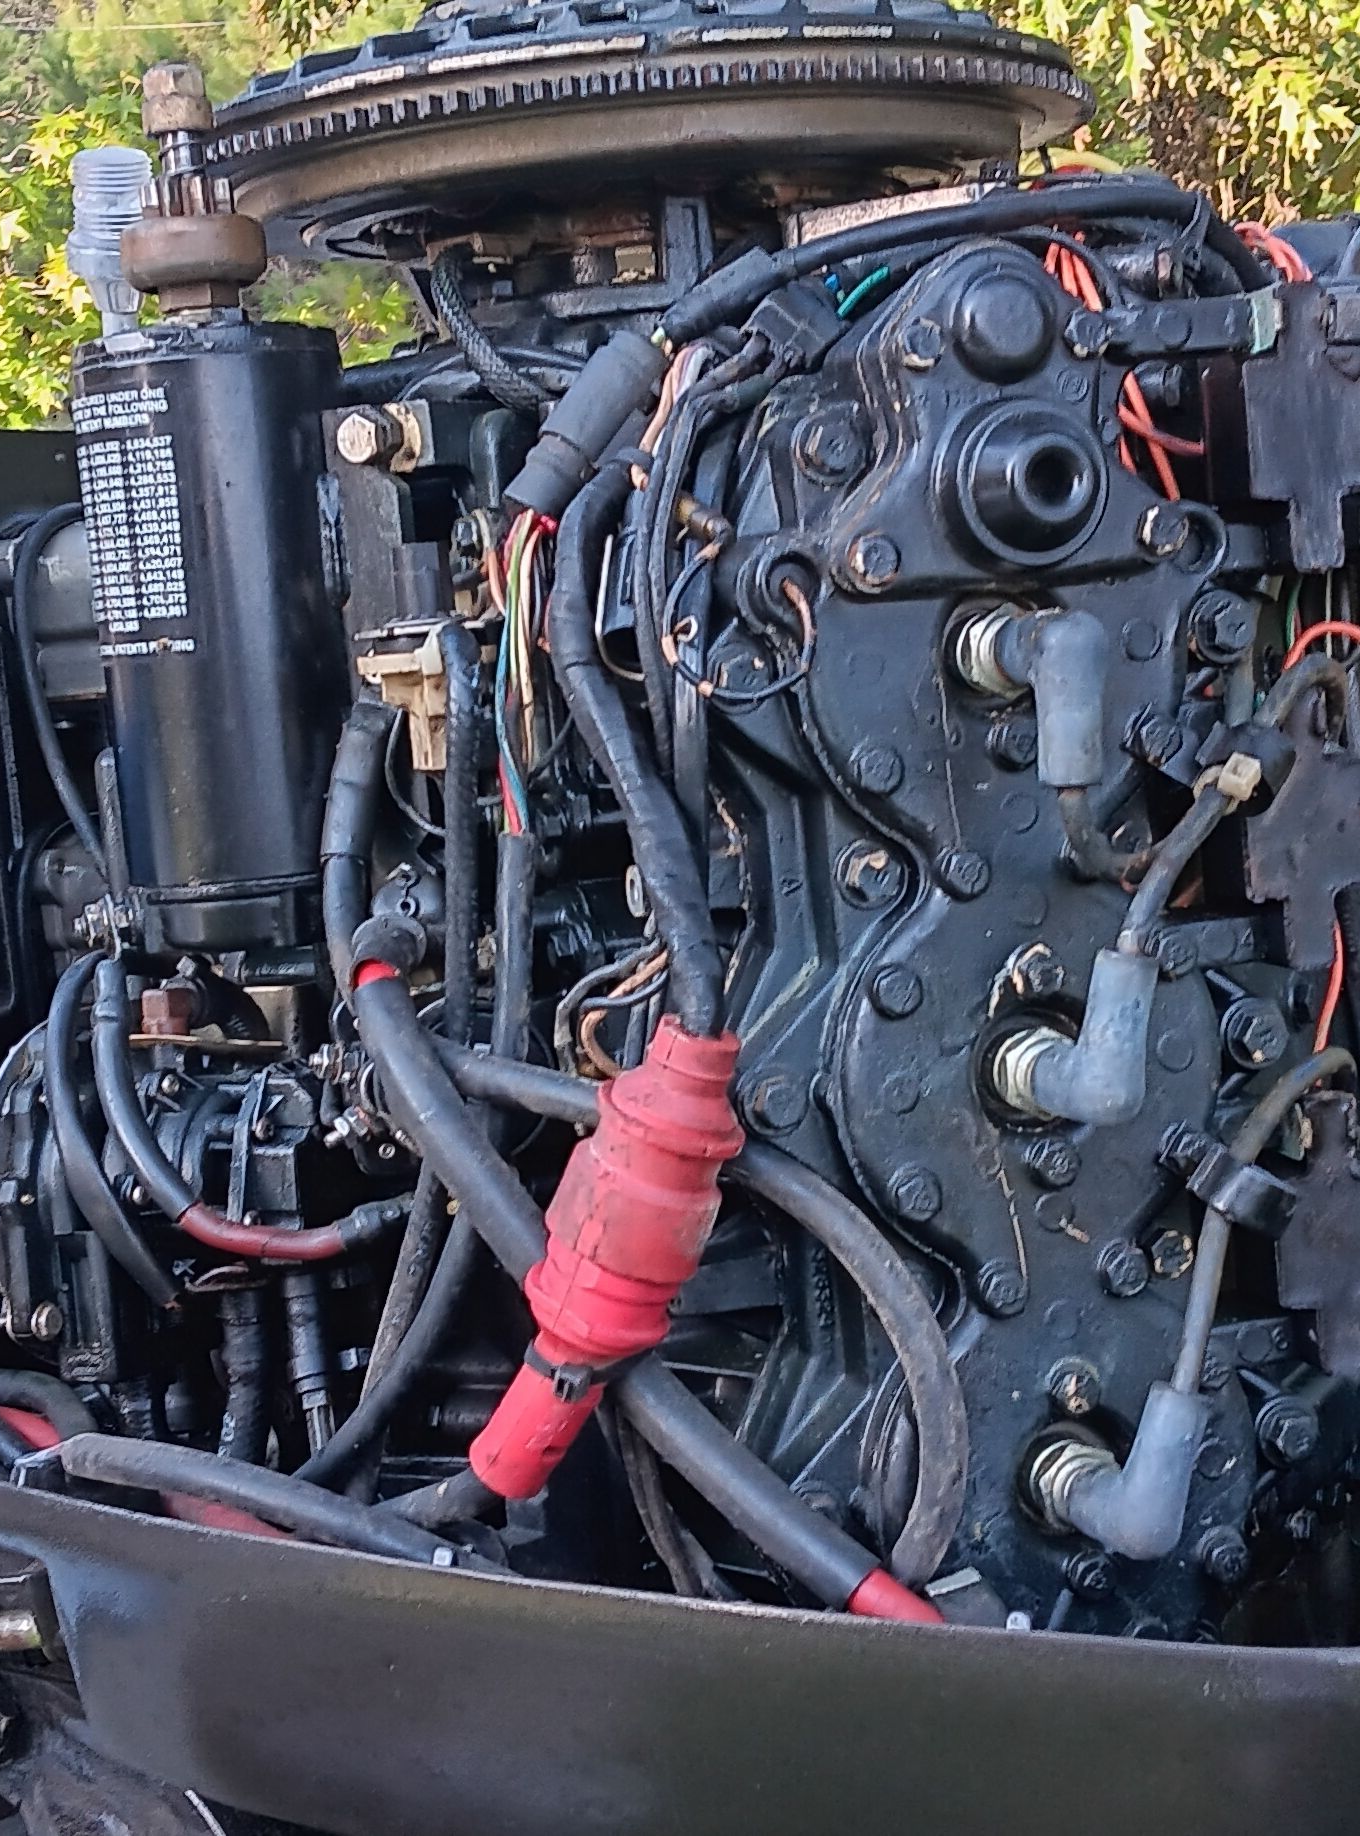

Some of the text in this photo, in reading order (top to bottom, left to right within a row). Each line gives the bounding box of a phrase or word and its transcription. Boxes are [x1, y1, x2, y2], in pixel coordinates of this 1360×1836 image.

[106, 390, 138, 402] UNDER
[140, 387, 165, 400] ONE
[93, 404, 106, 416] THE
[108, 400, 168, 416] FOLLOWING
[103, 413, 150, 430] NUMBERS
